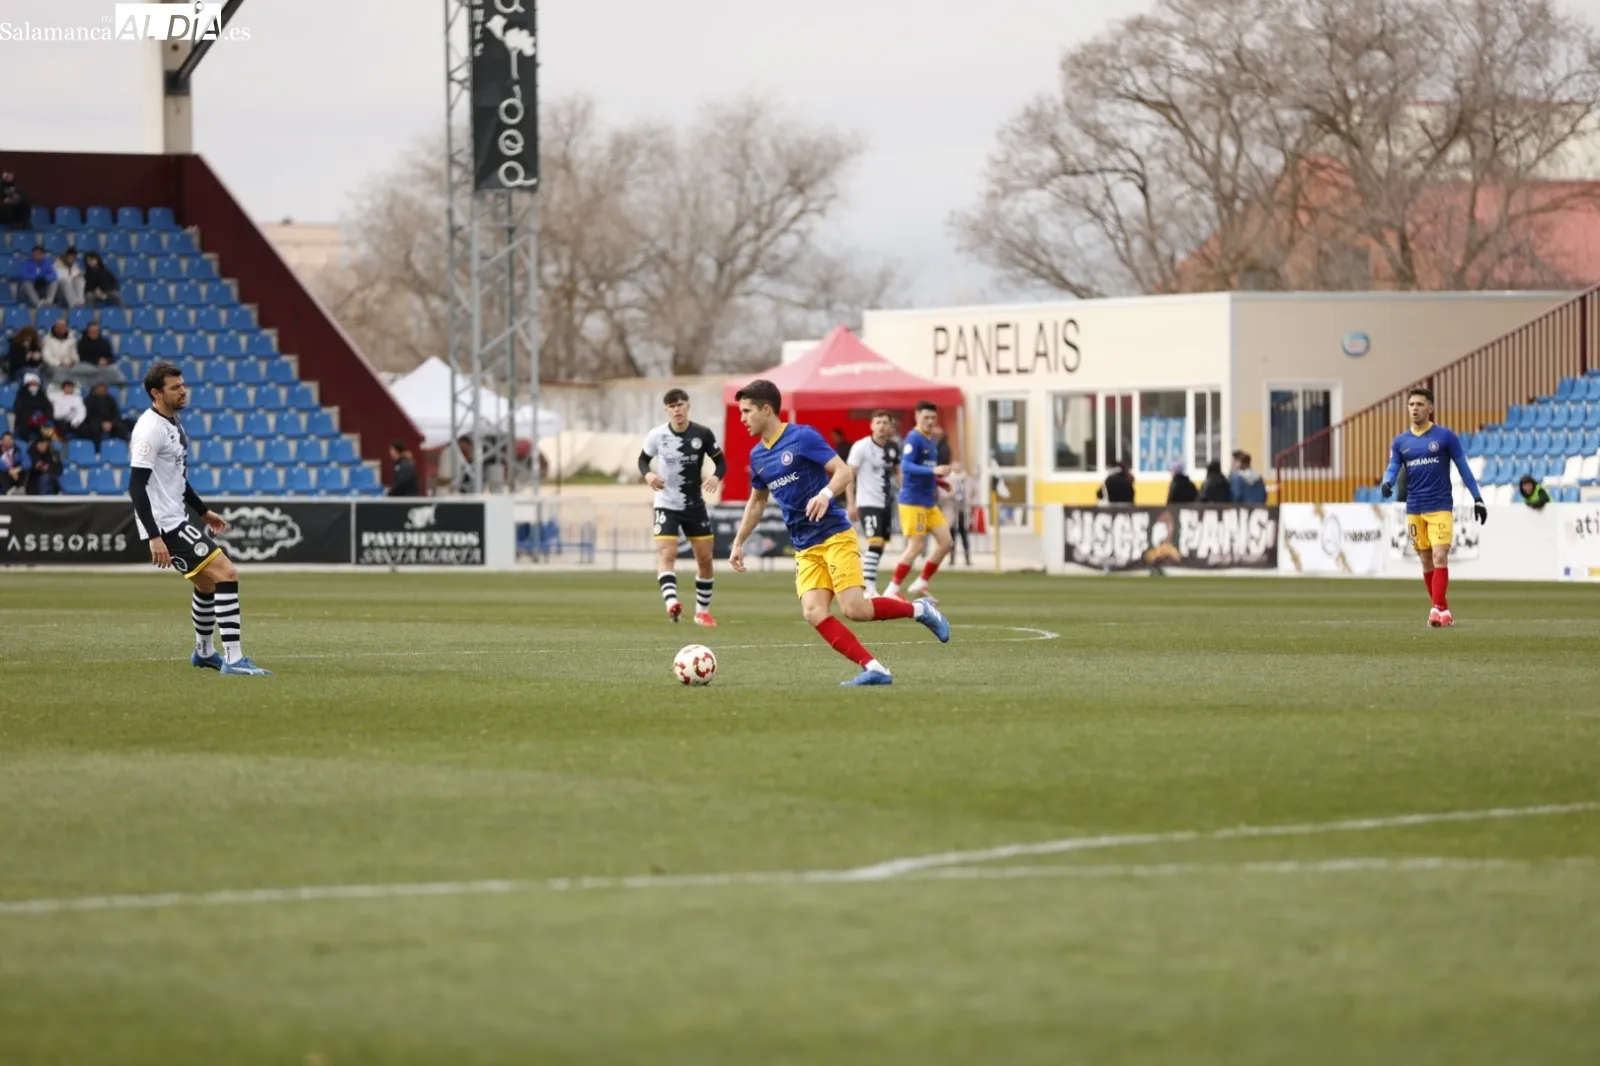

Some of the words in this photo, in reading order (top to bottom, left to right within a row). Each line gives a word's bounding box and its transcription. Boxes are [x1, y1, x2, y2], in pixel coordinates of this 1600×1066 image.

[932, 318, 1082, 377] PANELAIS
[655, 510, 667, 525] 16
[864, 514, 878, 530] 21
[7, 533, 128, 552] ASESORES
[178, 524, 202, 545] 10
[361, 531, 480, 547] PAVIMENTOS
[1178, 507, 1271, 562] FANS
